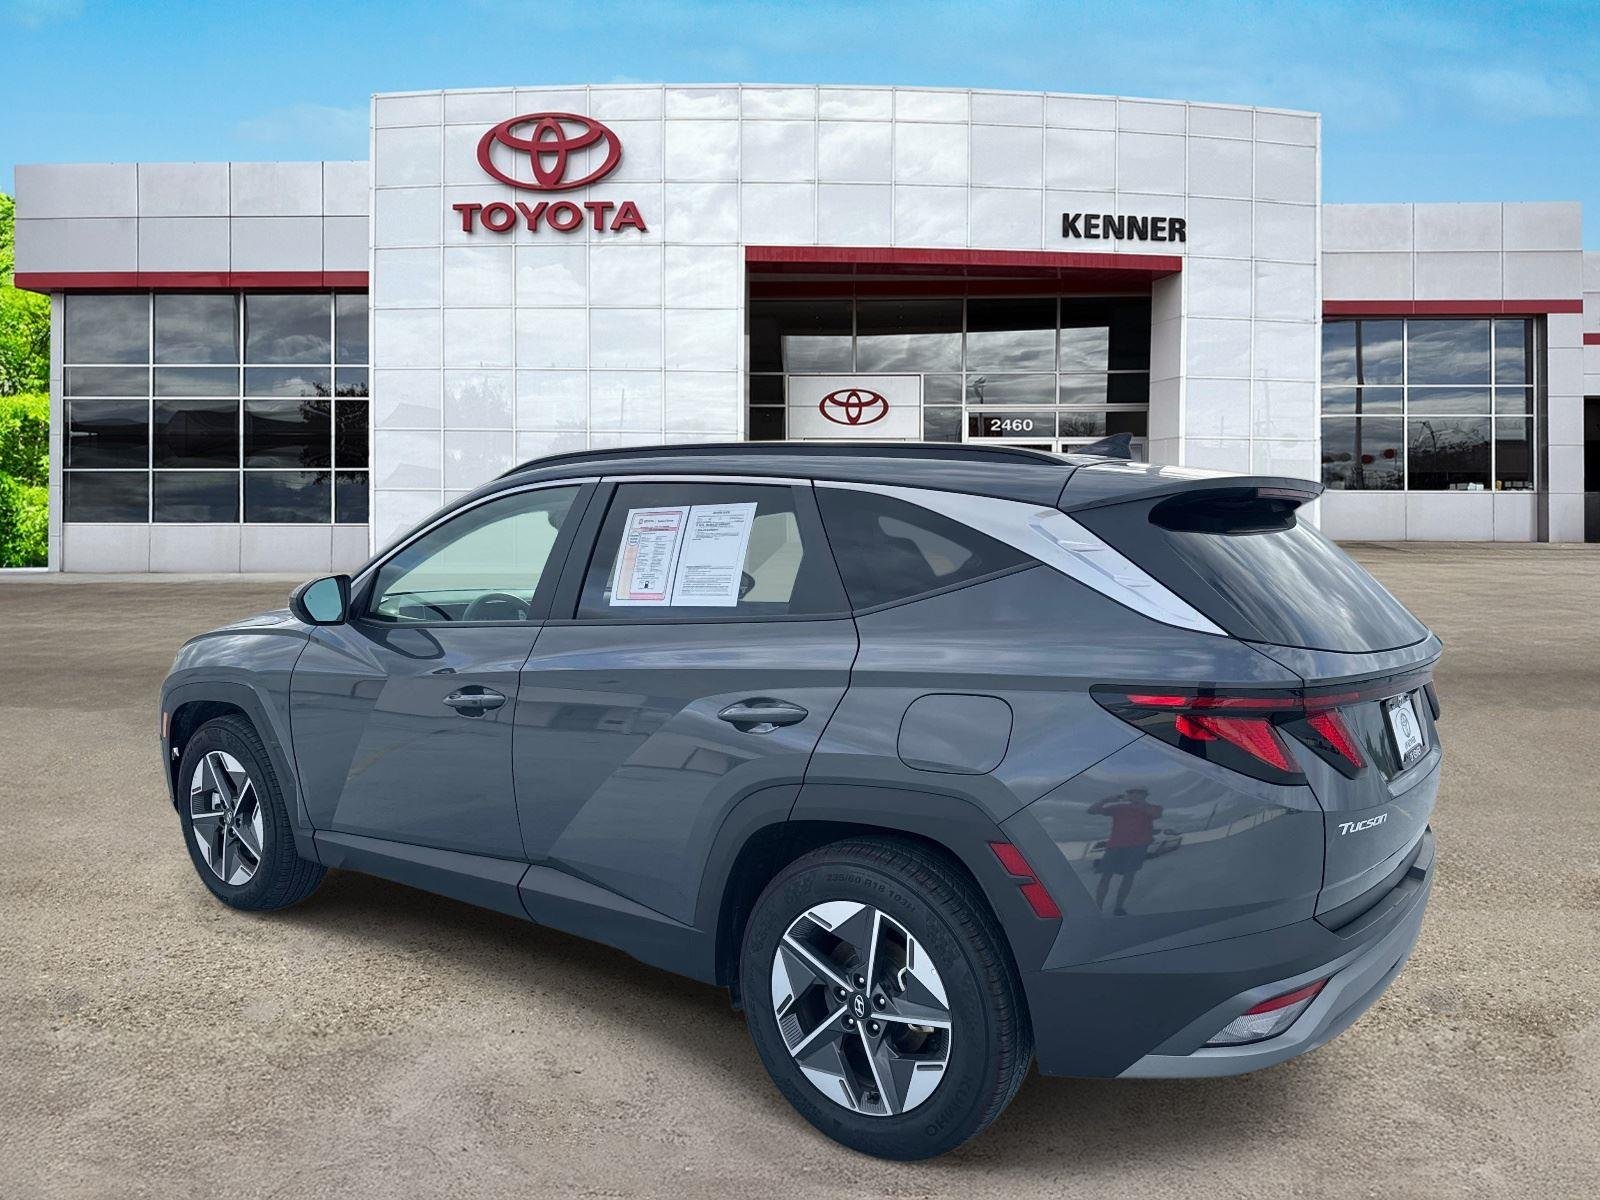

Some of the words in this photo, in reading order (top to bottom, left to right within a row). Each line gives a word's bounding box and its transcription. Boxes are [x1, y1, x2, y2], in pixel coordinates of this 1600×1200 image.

[452, 201, 647, 232] TOYOTA
[1062, 213, 1187, 242] KENNER
[990, 418, 1033, 431] 2460
[1338, 812, 1388, 835] Tucson
